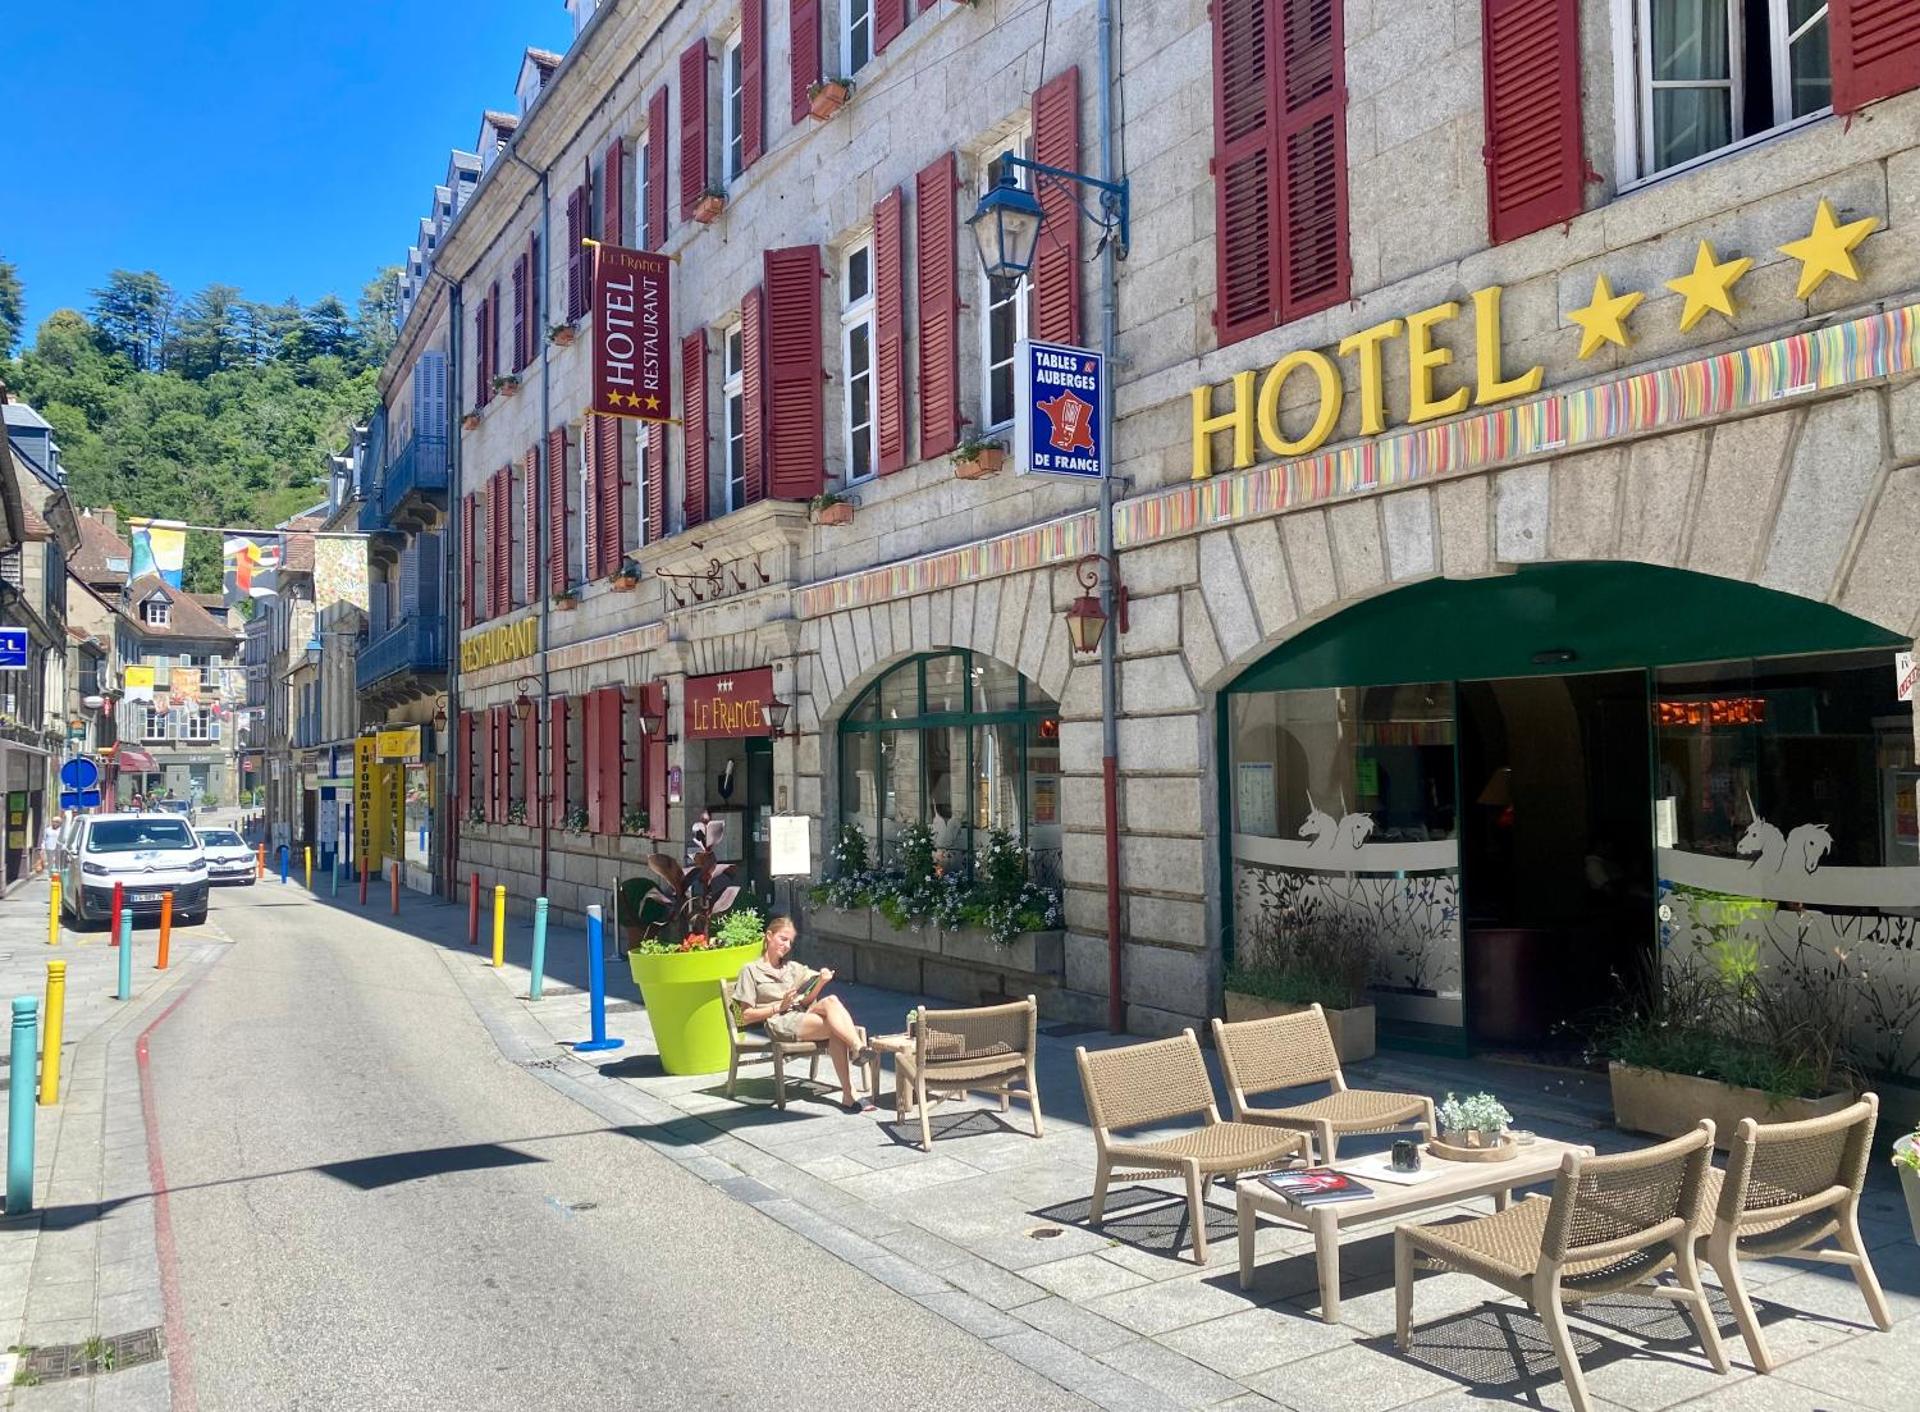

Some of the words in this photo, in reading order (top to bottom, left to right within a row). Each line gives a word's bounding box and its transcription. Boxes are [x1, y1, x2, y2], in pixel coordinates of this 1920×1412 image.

[621, 253, 665, 274] FRANCE
[606, 273, 635, 386] HOTEL
[643, 275, 660, 391] RESTAURANT
[1036, 351, 1077, 372] TABLES
[1036, 369, 1096, 391] AUBERGES
[1190, 285, 1543, 479] HOTEL
[1035, 452, 1050, 467] DE
[1055, 456, 1099, 472] FRANCE
[461, 616, 537, 672] RESTAURANT
[693, 699, 708, 731] LE
[712, 698, 760, 734] FRANCE
[360, 745, 372, 857] INFORMATIQUE
